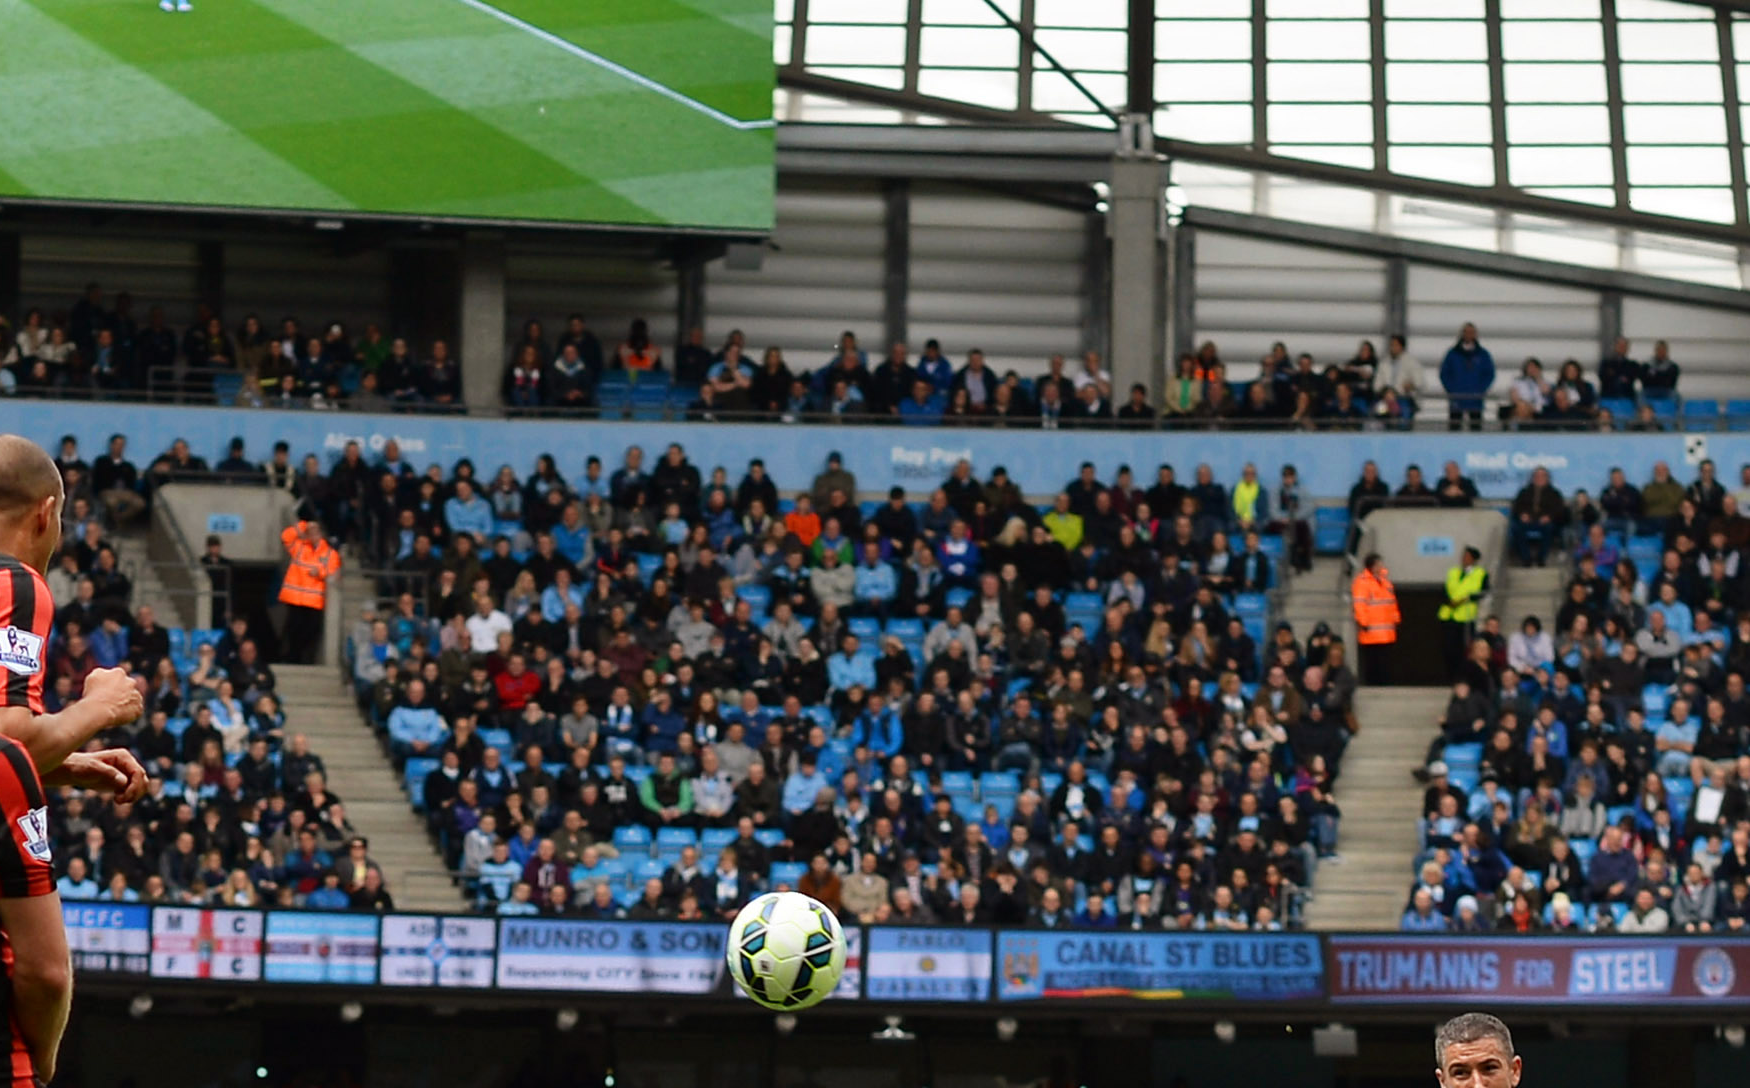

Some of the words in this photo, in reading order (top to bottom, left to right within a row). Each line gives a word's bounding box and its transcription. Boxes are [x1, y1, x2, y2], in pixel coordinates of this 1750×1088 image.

[506, 926, 620, 950] MUNRO
[630, 929, 648, 951] &
[1055, 939, 1154, 967] CANAL
[1165, 940, 1204, 967] ST
[1212, 941, 1313, 969] BLUES
[1337, 950, 1501, 991] TRUMANNS
[1513, 959, 1555, 988] FOR
[1575, 948, 1666, 992] STEEL
